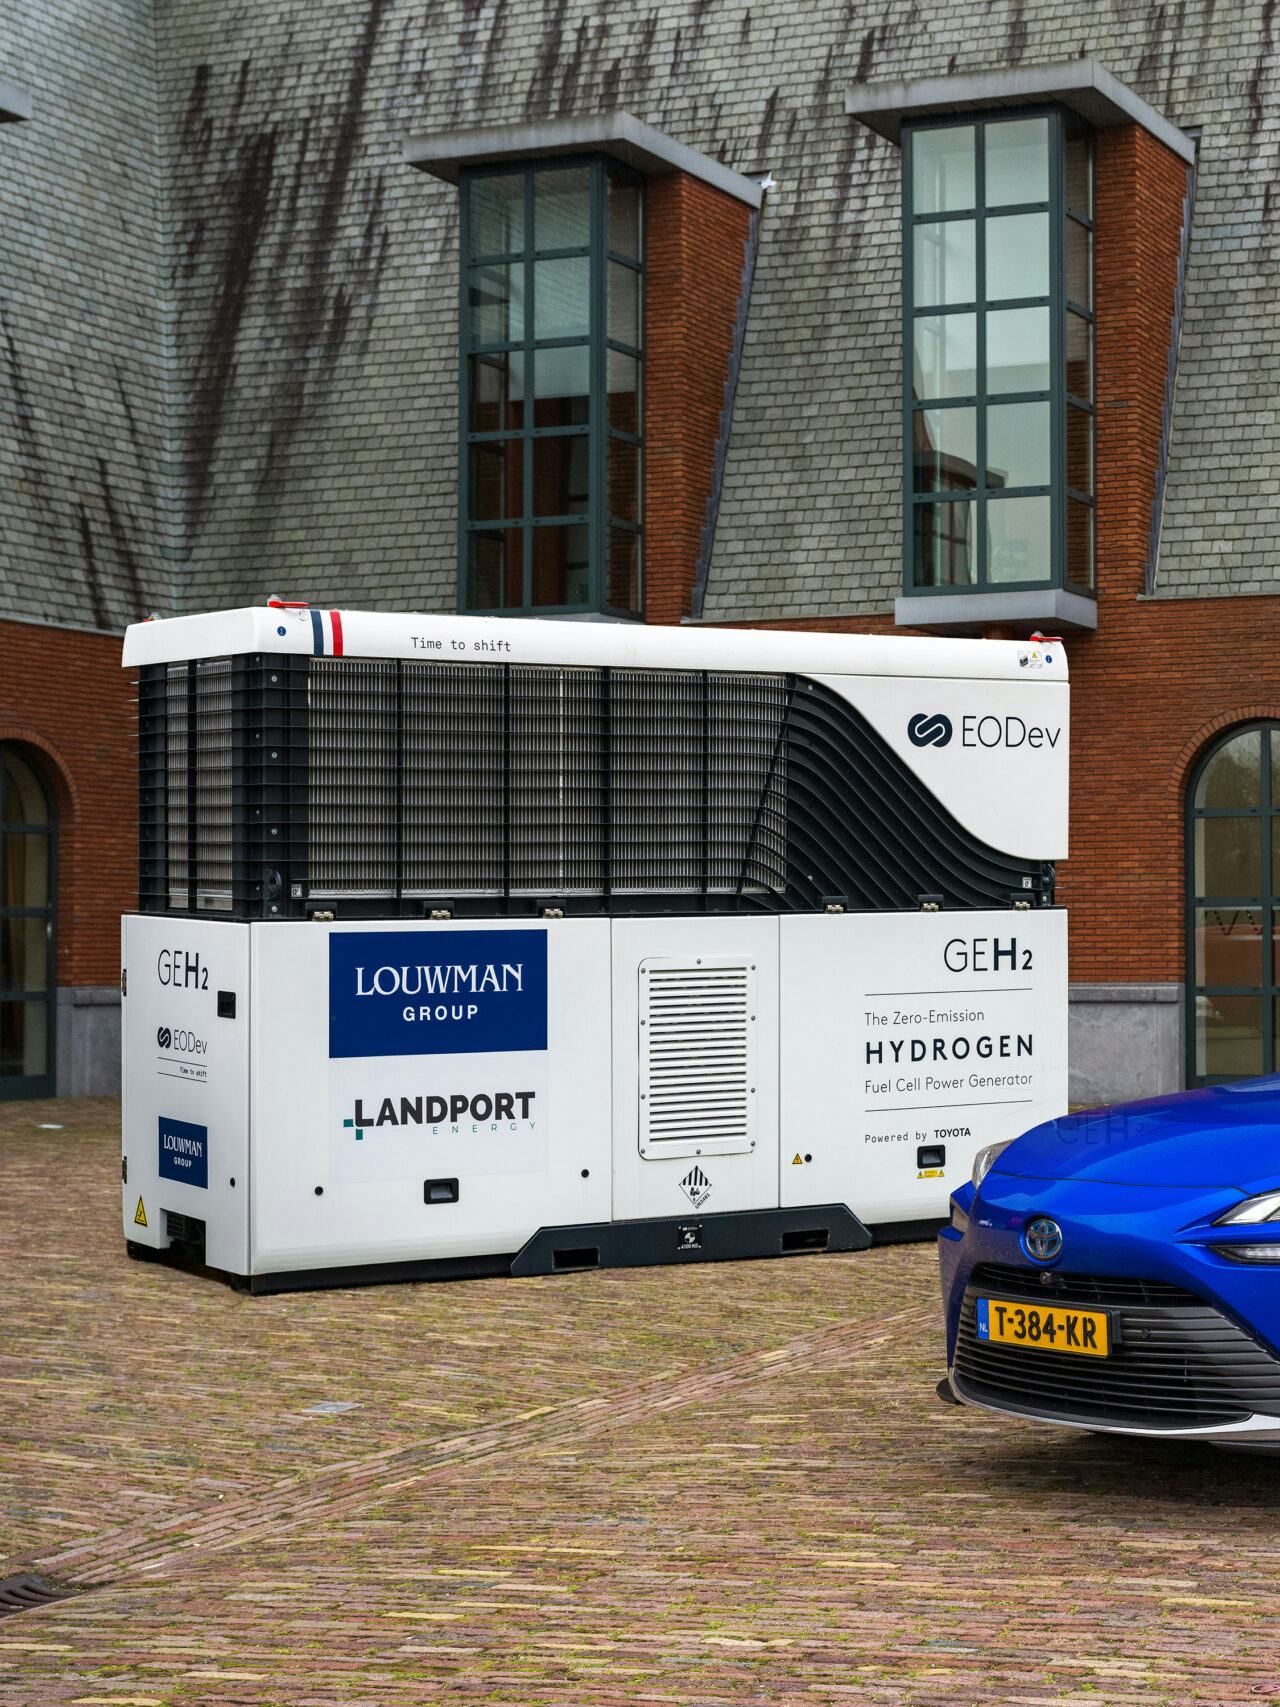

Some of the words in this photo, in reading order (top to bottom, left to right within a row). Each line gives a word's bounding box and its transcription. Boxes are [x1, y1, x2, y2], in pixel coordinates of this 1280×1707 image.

[410, 636, 442, 650] Time
[450, 639, 466, 651] to
[473, 639, 511, 652] shift
[962, 715, 1061, 749] EODev
[943, 937, 1034, 973] GEH2
[157, 948, 209, 991] GEH2
[355, 963, 524, 996] LOUWMAN
[402, 1004, 479, 1022] GROUP
[864, 1012, 888, 1026] The
[892, 1008, 985, 1026] Zero-Emission
[173, 1029, 207, 1054] EODev
[865, 1033, 1033, 1065] HYDROGEN
[865, 1079, 893, 1094] Fuel
[895, 1077, 921, 1093] Cell
[925, 1076, 965, 1091] Power
[968, 1073, 1033, 1089] Generator
[354, 1091, 536, 1128] LANDPORT
[432, 1121, 536, 1136] ENERGY
[864, 1132, 909, 1144] Powered
[915, 1131, 927, 1142] by
[934, 1127, 971, 1139] TOYOTA
[163, 1133, 202, 1158] LOUWMAN
[173, 1156, 192, 1168] GROUP
[979, 1322, 988, 1333] NL
[995, 1306, 1097, 1348] T-384-KR
